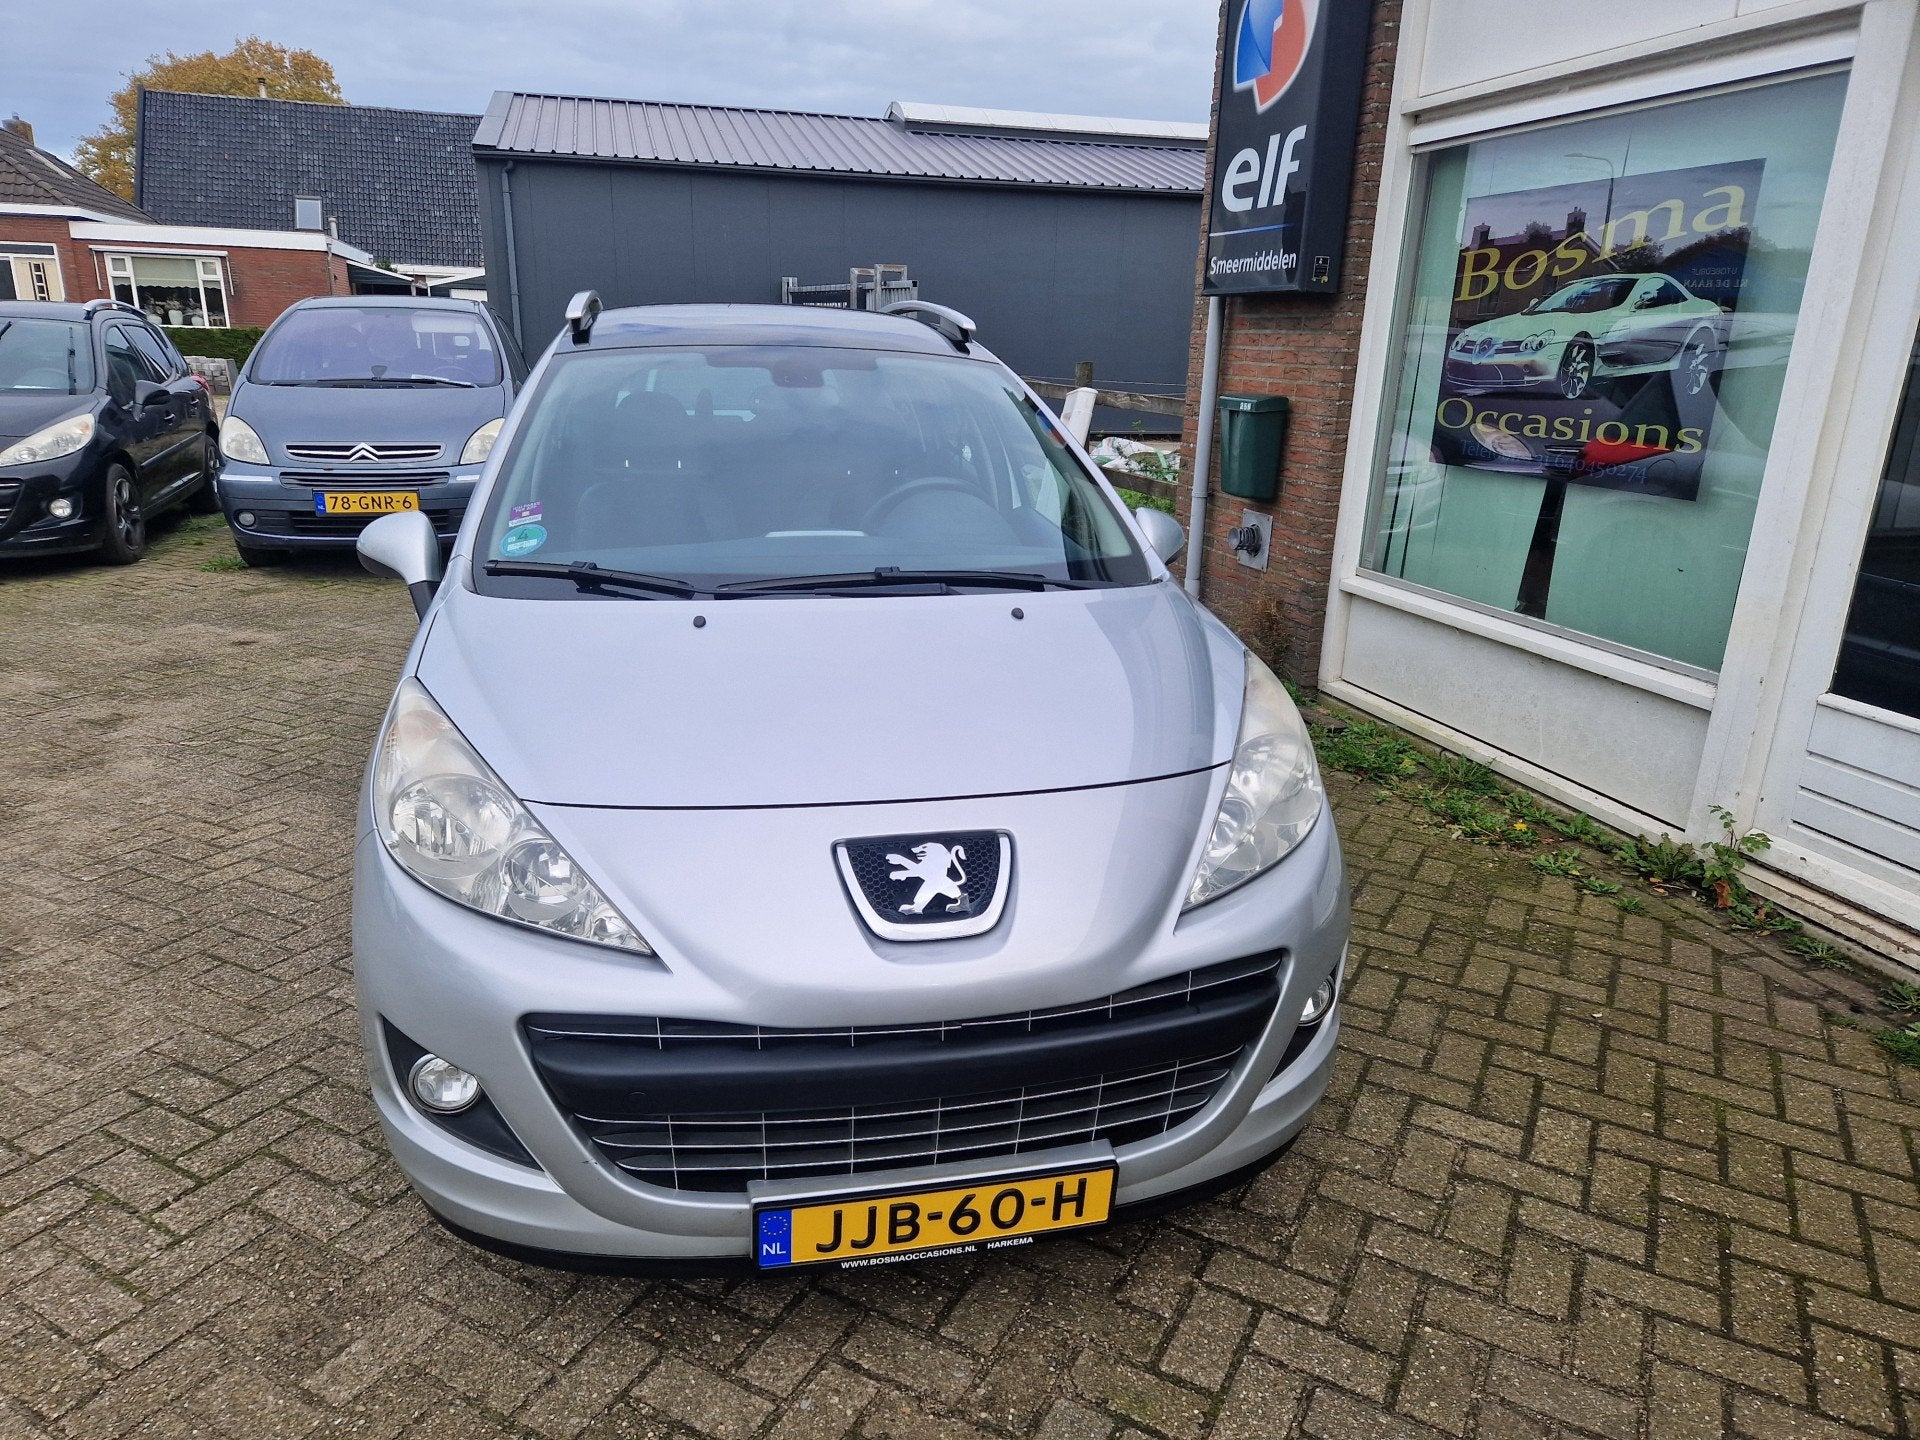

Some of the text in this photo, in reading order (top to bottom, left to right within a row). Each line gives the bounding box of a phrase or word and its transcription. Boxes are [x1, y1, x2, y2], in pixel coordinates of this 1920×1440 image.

[1222, 125, 1307, 213] elf
[1209, 249, 1297, 276] Smeermiddelen
[1455, 184, 1748, 302] Bosma
[1437, 397, 1704, 455] Occasions
[329, 496, 412, 510] 78-GNR-6
[815, 1178, 1087, 1254] JJB-60-H
[762, 1242, 786, 1256] NL
[840, 1236, 1034, 1269] WWW.BOSMAOCCASIONS.NL HARKEMA
